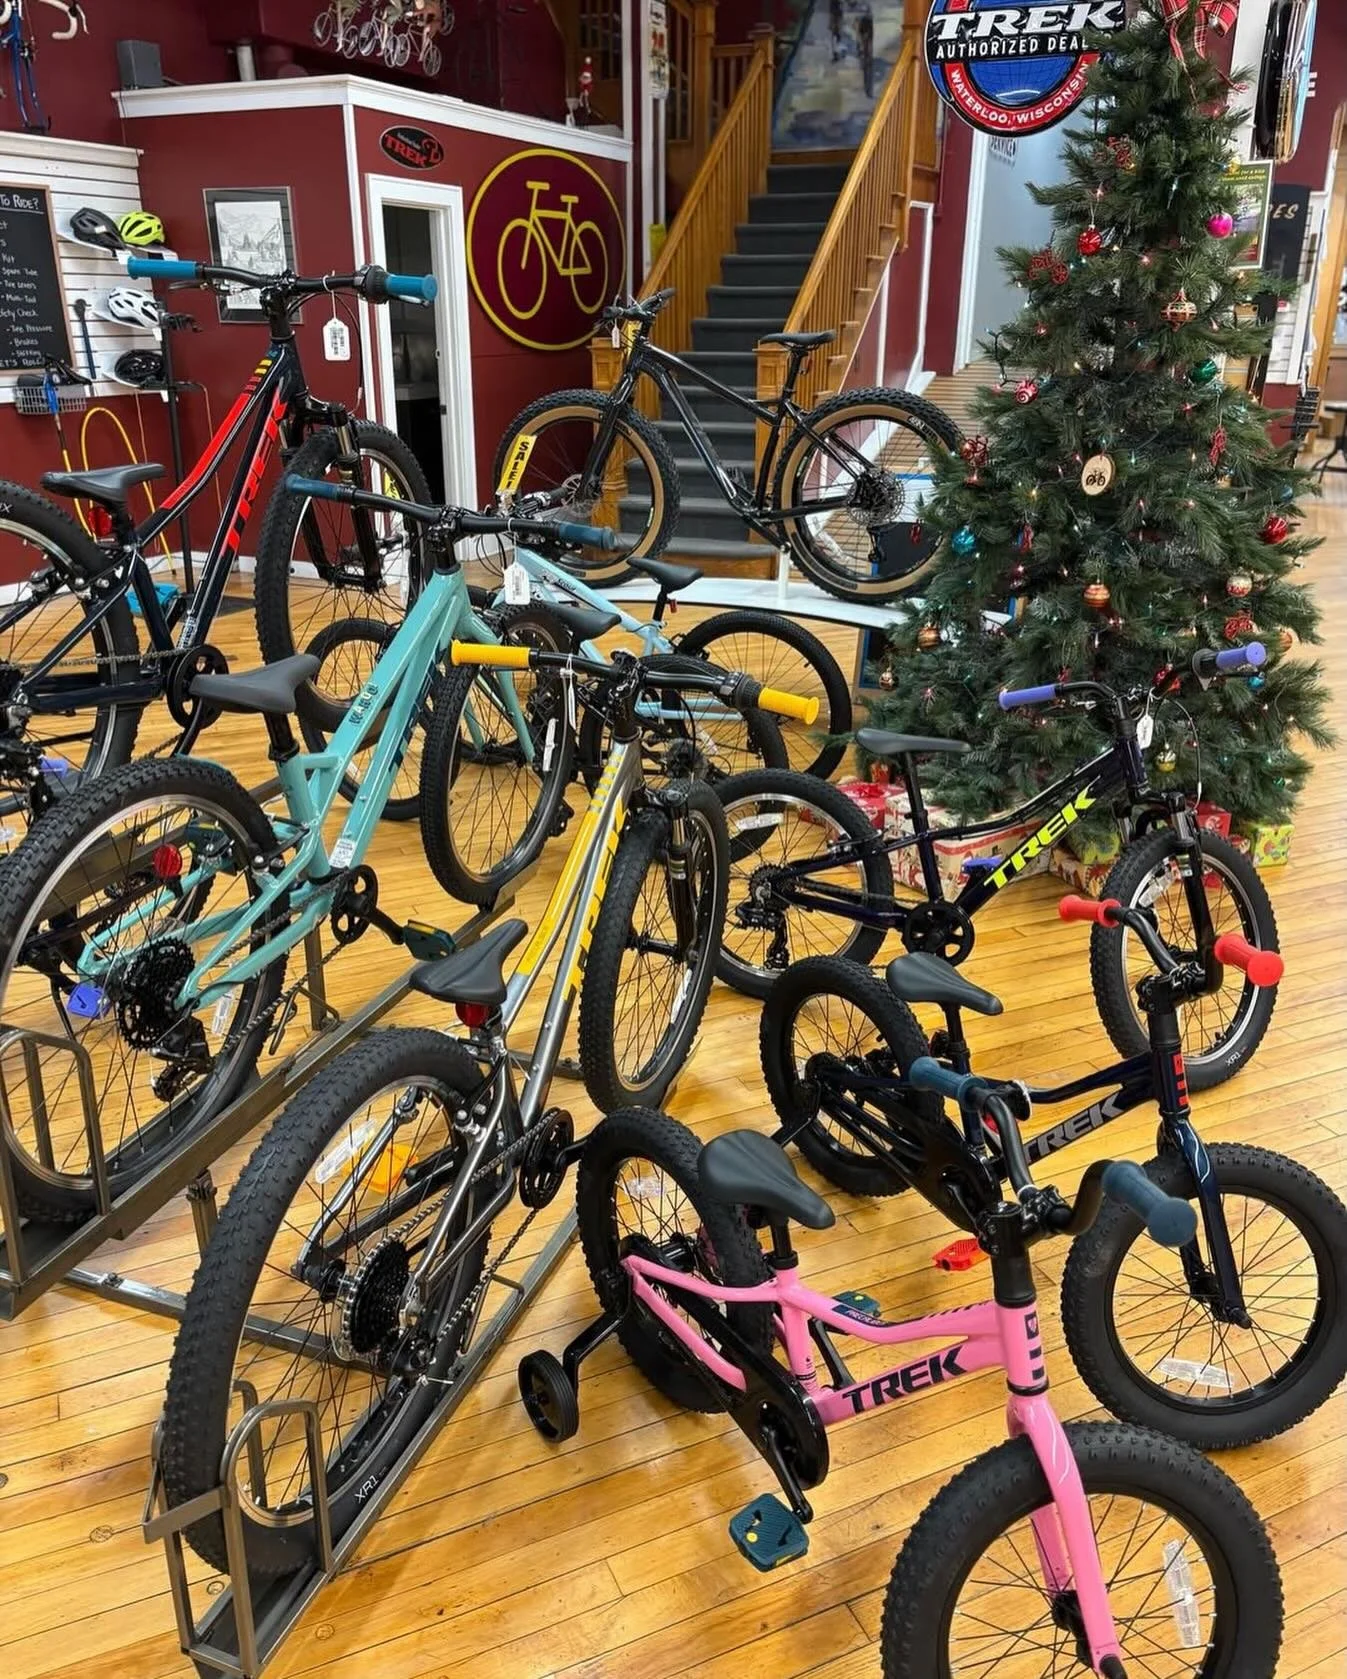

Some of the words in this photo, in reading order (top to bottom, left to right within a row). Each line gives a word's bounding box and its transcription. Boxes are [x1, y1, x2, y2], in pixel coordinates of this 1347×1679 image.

[931, 0, 1122, 41] TREK
[935, 38, 1040, 60] AUTHORIZED
[384, 133, 427, 169] TREK
[12, 194, 40, 210] RIDE?
[221, 386, 288, 556] TREK
[983, 774, 1101, 889] TREK
[841, 1345, 968, 1415] TREK
[354, 1475, 380, 1504] XR1
